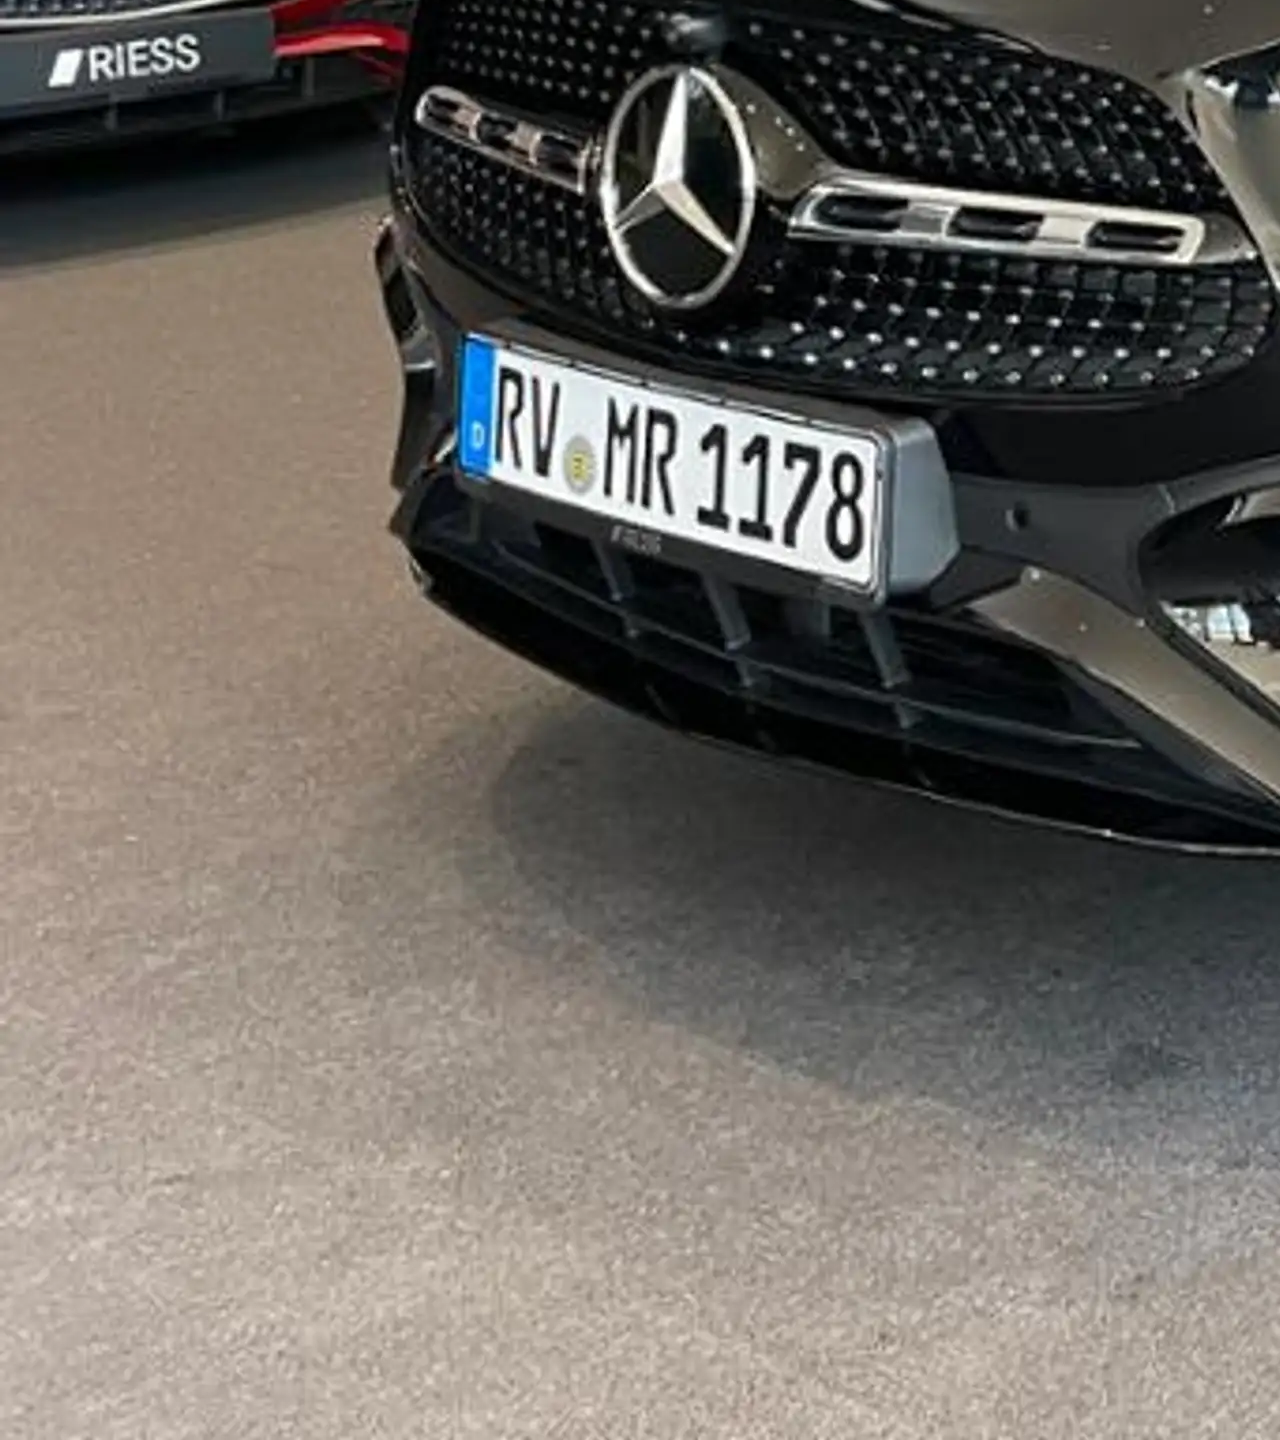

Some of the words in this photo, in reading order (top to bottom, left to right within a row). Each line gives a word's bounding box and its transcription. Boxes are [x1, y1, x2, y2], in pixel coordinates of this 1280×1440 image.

[89, 34, 201, 82] RIESS
[496, 367, 561, 478] RV
[603, 397, 678, 516] MR
[697, 423, 864, 561] 1178
